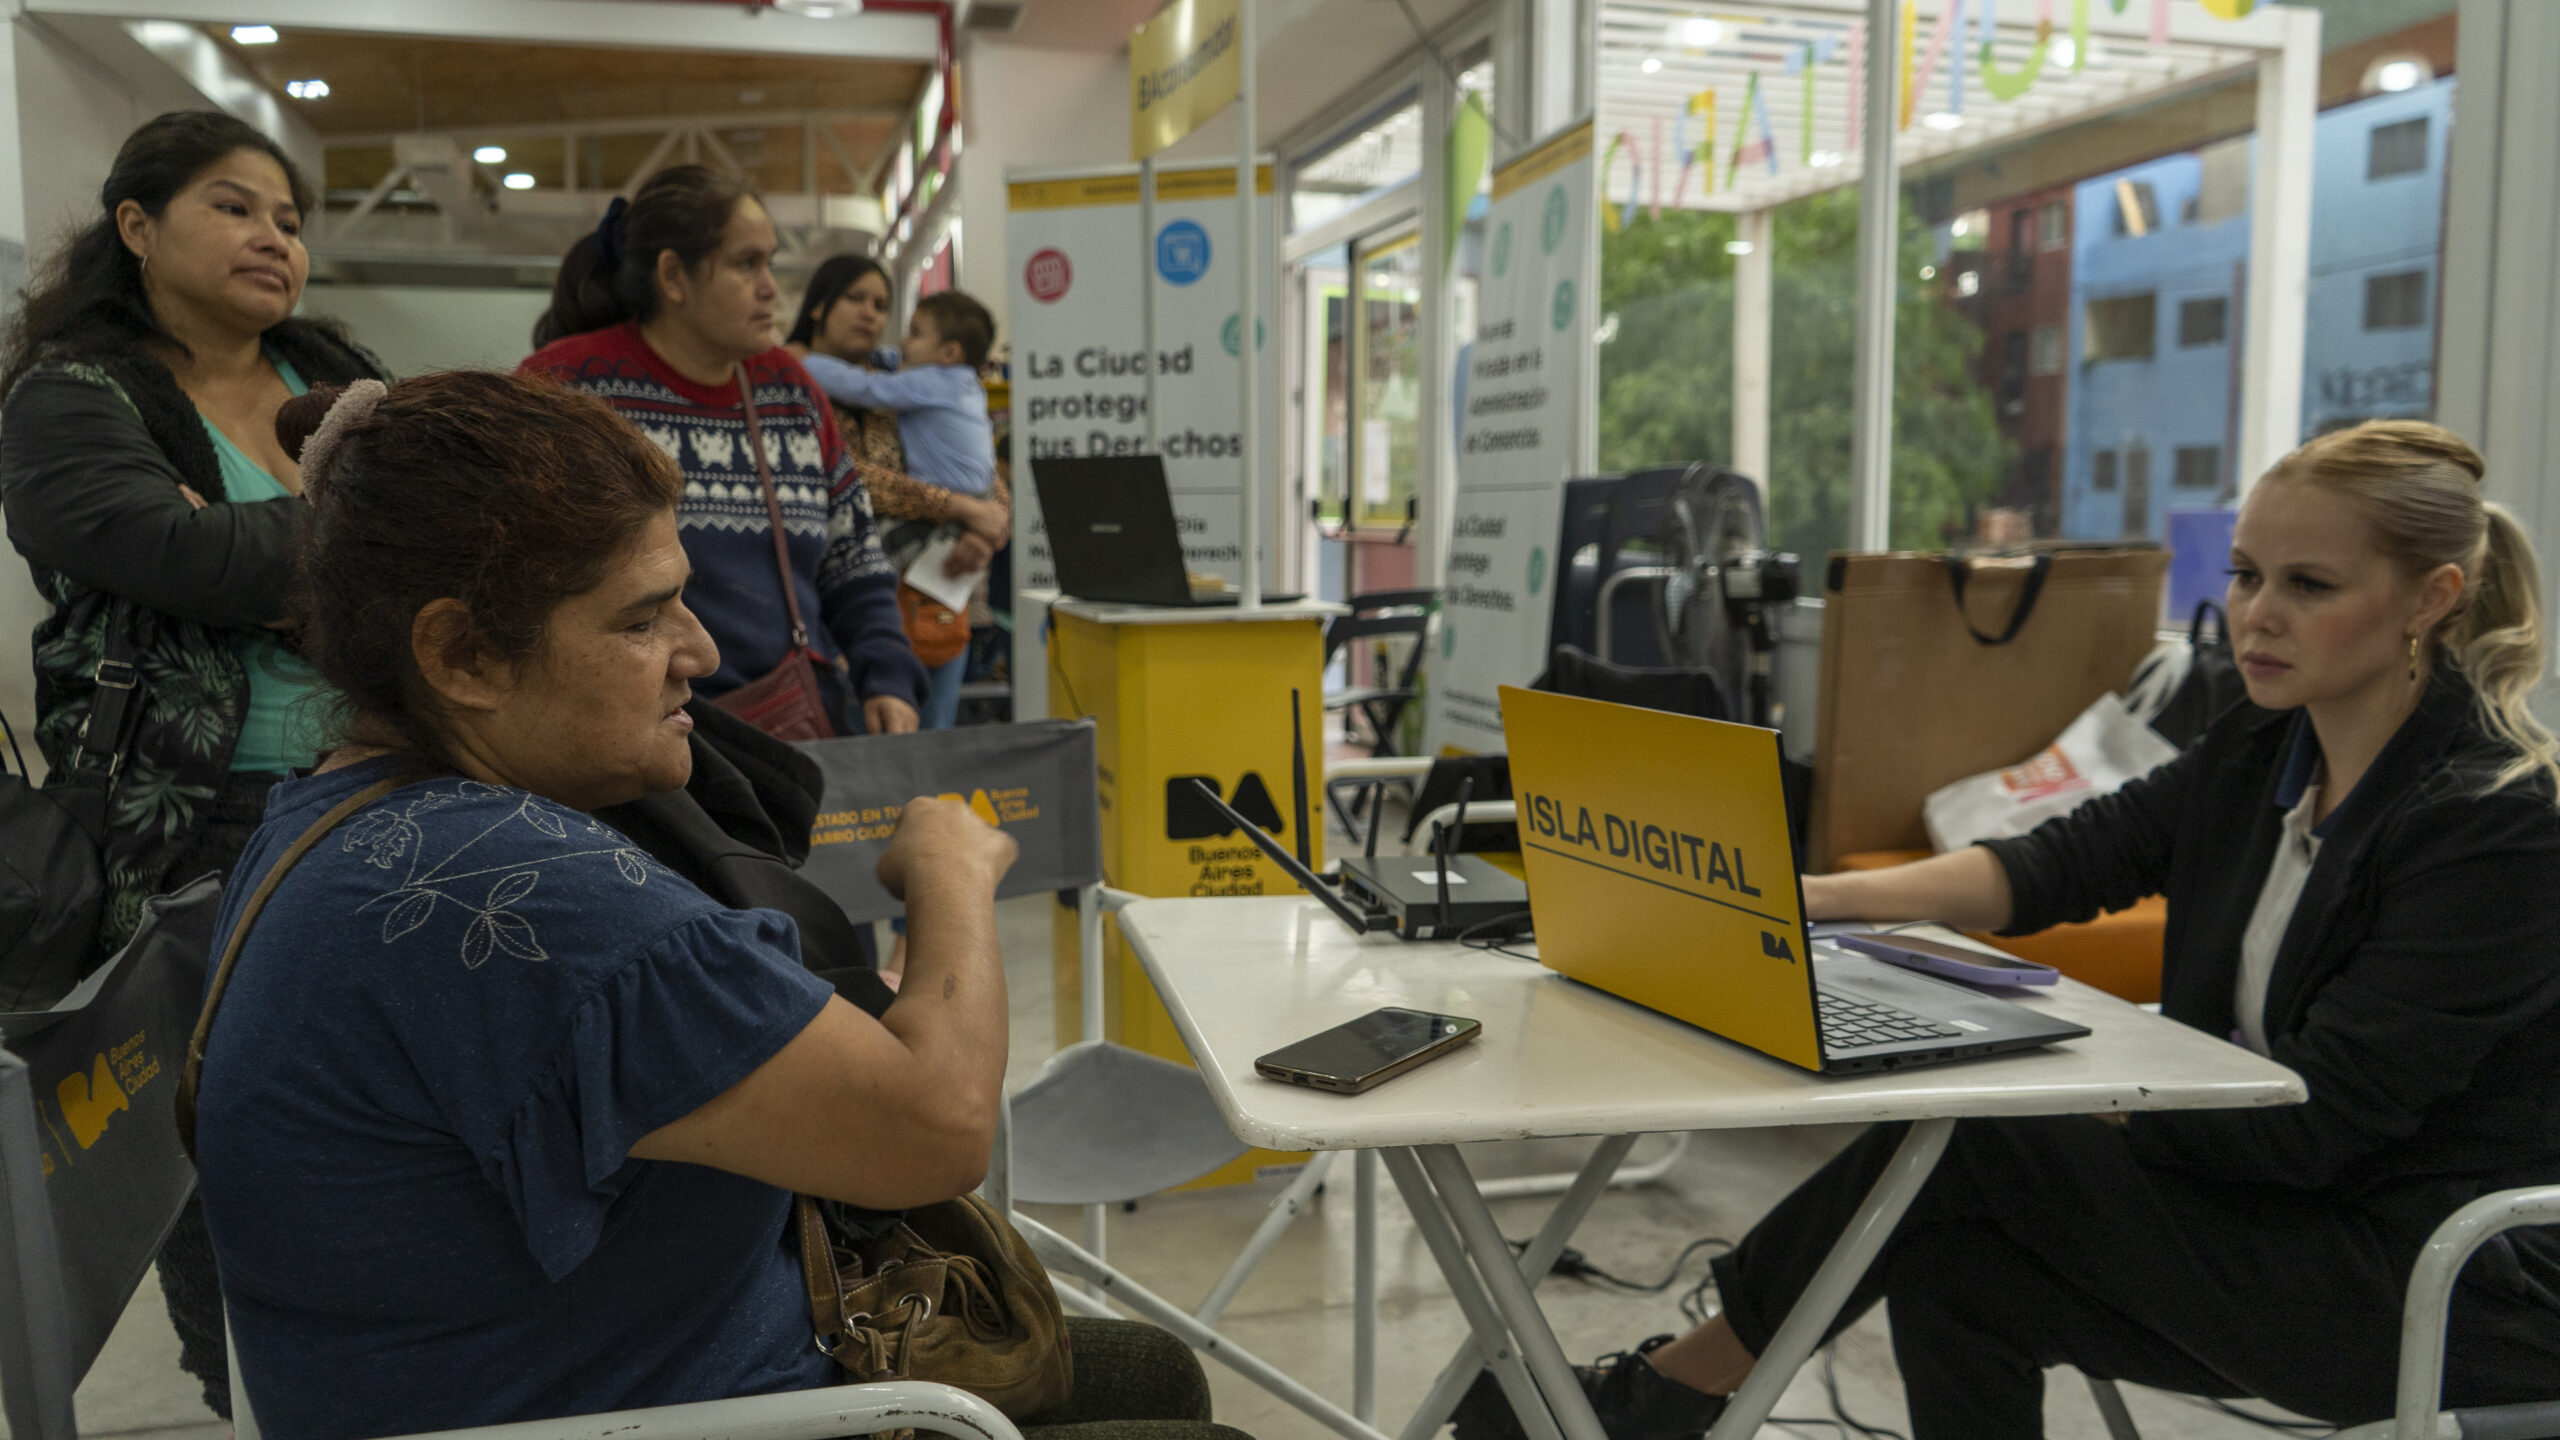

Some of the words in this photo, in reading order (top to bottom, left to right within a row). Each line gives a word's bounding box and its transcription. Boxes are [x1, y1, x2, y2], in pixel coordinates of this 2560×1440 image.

[1028, 351, 1064, 378] La
[1028, 434, 1076, 459] tus
[1088, 429, 1242, 459] Derchos
[813, 810, 859, 829] STADO
[861, 808, 881, 823] EN
[1002, 805, 1039, 822] Ciudad
[1167, 773, 1283, 839] BA
[1190, 846, 1263, 864] Buenos
[1525, 792, 1600, 851] ISLA
[1604, 814, 1762, 898] DIGITAL
[1190, 877, 1264, 896] Ciudad
[1201, 865, 1254, 880] Aires
[1760, 931, 1795, 964] BA
[110, 1029, 146, 1065] Buenos
[119, 1051, 144, 1080] Aires
[125, 1055, 160, 1095] Ciudad
[57, 1053, 129, 1150] BA
